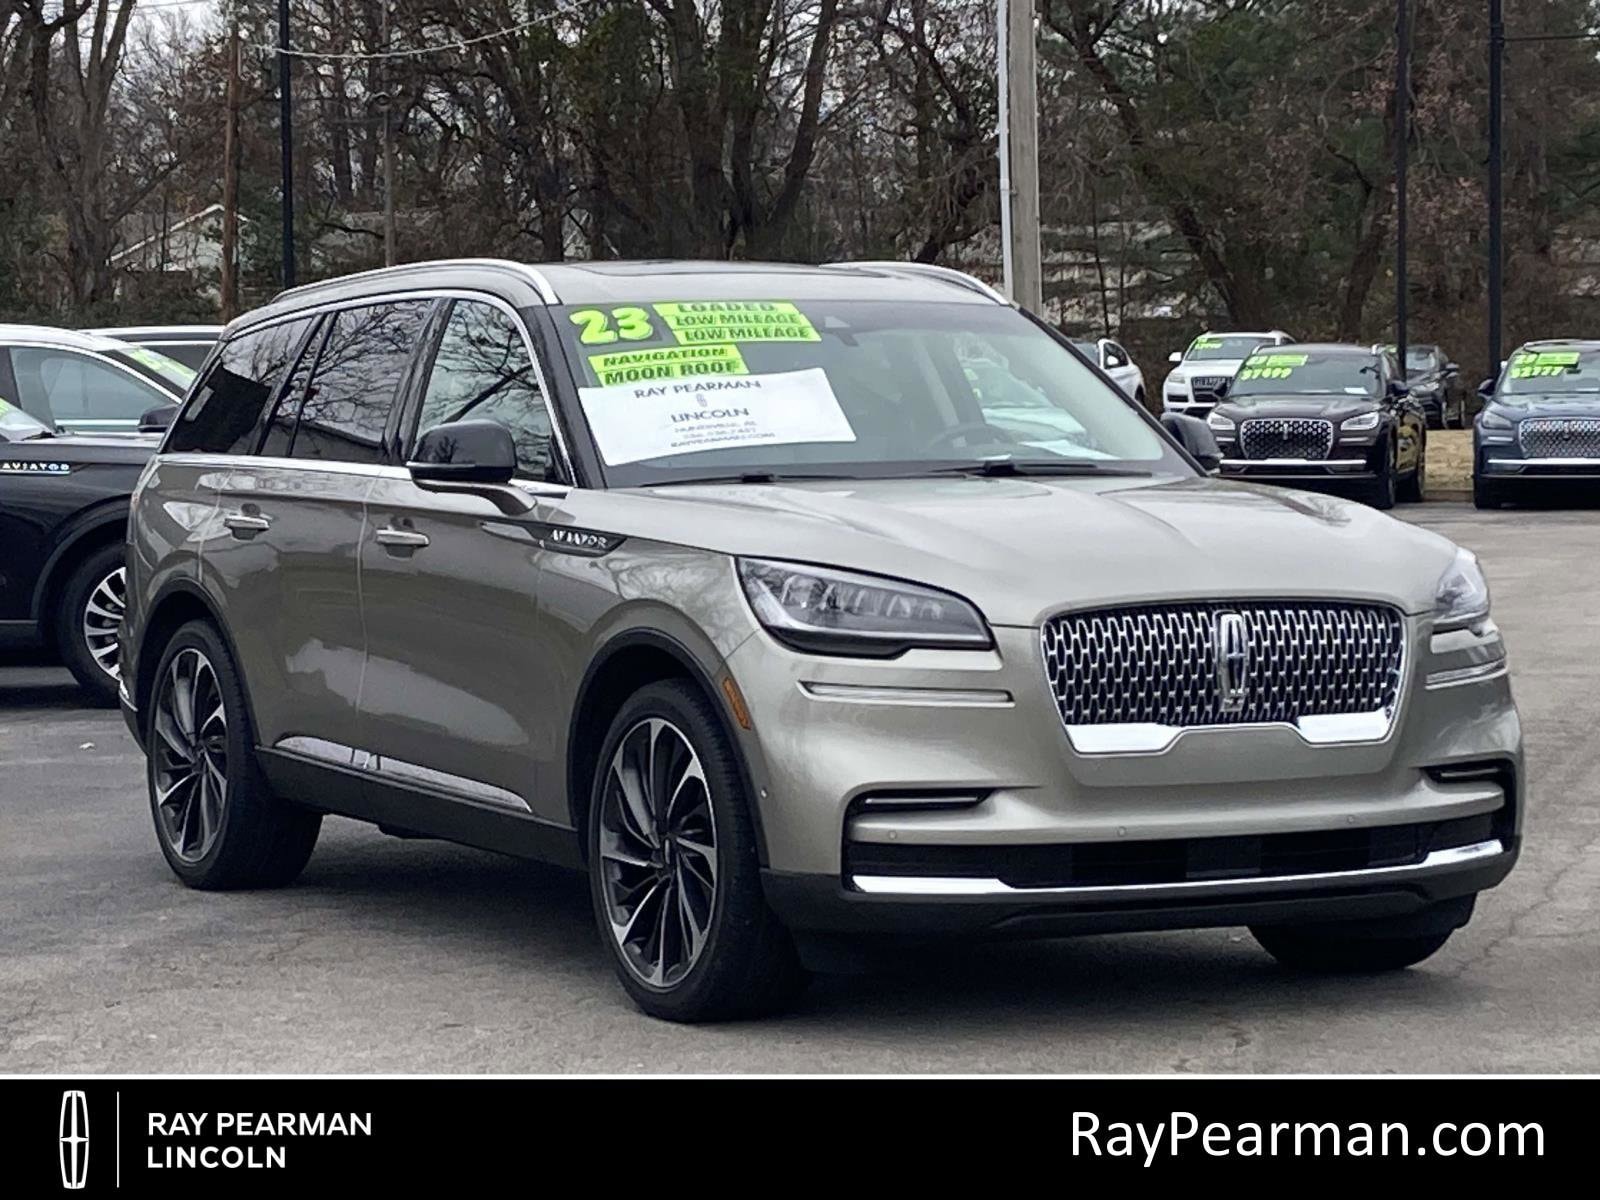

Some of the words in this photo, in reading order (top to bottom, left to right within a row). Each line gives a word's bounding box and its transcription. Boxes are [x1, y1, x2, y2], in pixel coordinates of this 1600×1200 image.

[678, 303, 776, 313] LOADED
[569, 307, 654, 345] 23
[676, 314, 714, 326] LOW
[720, 313, 799, 325] MILEAGE
[685, 328, 723, 342] LOW
[730, 326, 811, 340] MILEAGE
[603, 347, 729, 367] NAVIGATION
[604, 365, 672, 386] MOON
[680, 359, 739, 377] ROOF
[633, 386, 667, 399] RAY
[673, 380, 762, 395] PEARMAN
[670, 407, 750, 423] LINCOLN
